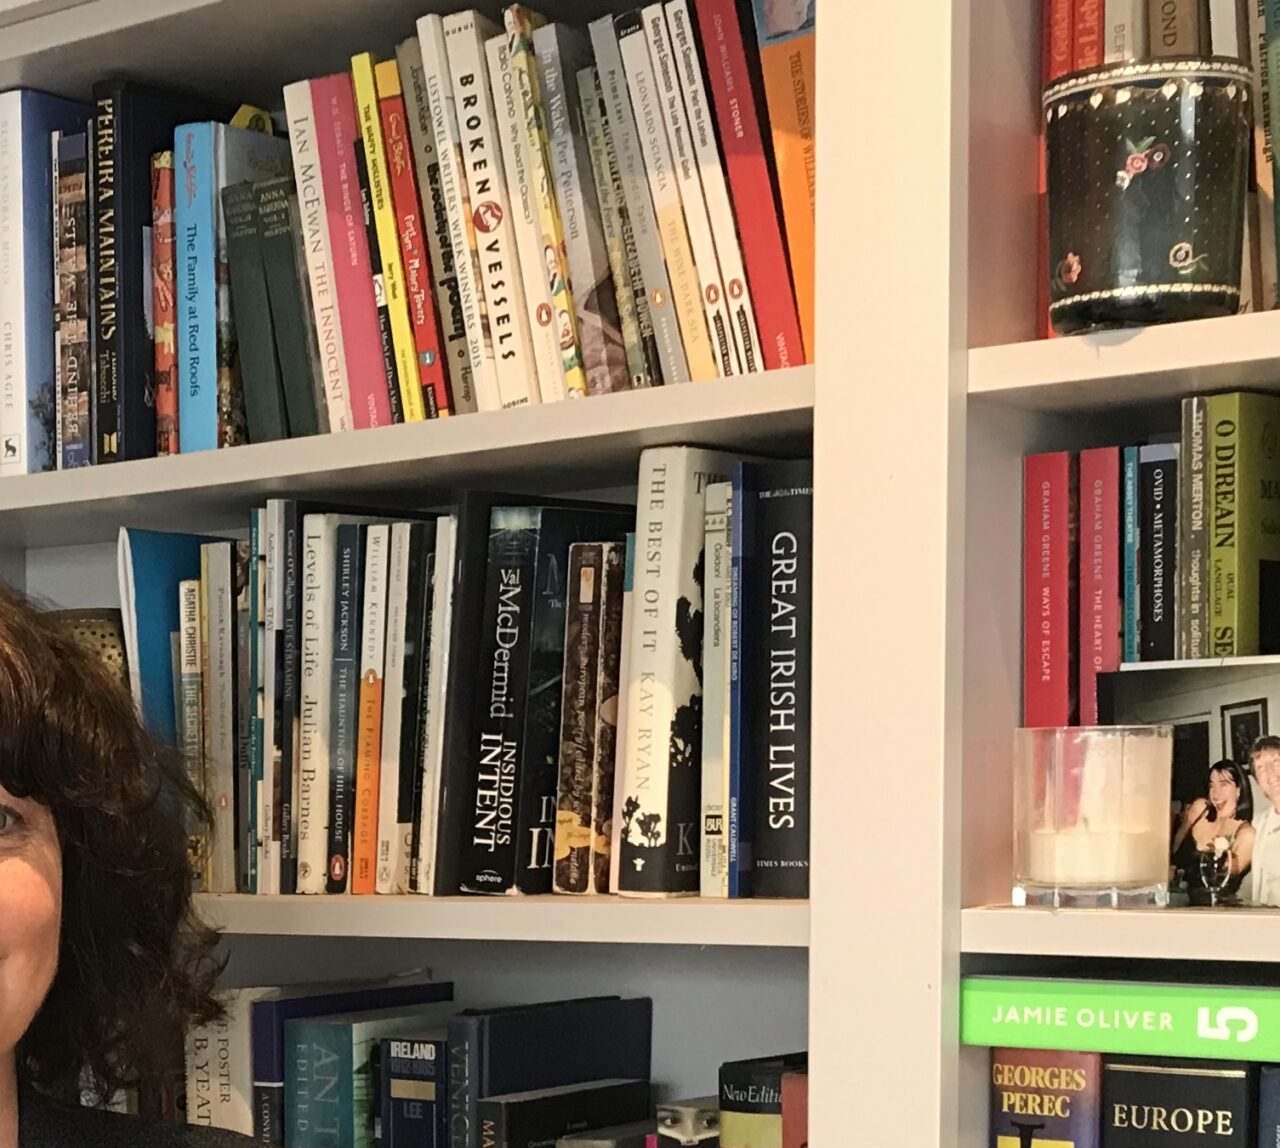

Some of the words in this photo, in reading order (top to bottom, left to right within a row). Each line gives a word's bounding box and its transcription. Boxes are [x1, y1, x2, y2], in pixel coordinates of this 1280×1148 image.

[540, 47, 552, 63] In
[544, 63, 558, 88] the
[364, 103, 372, 122] THE
[458, 72, 492, 196] BROKEN
[549, 90, 564, 135] Wake
[634, 70, 654, 138] LEONARDO
[649, 137, 668, 193] SCIASCIA
[97, 97, 115, 204] PEREIRA
[366, 122, 376, 153] HAPPY
[370, 155, 385, 211] HOLLISTERS
[428, 74, 447, 147] LISTOWEL
[452, 212, 464, 257] WEEK
[459, 258, 477, 331] WINNERS
[559, 168, 580, 241] Petterson
[186, 222, 197, 253] The
[97, 207, 116, 341] MAINTAINS
[186, 253, 198, 304] Family
[188, 303, 198, 320] at
[484, 239, 517, 362] VESSELS
[4, 322, 12, 365] CHRIS
[188, 322, 199, 351] Red
[5, 371, 13, 410] AGEE
[189, 353, 200, 398] Roofs
[1191, 410, 1203, 471] THOMAS
[650, 463, 667, 511] THE
[1041, 481, 1051, 530] GRAHAM
[1093, 479, 1103, 531] GRAHAM
[1153, 468, 1164, 502] OVID
[1191, 473, 1203, 531] MERTON
[305, 533, 323, 603] Levels
[370, 535, 382, 596] WILLIAM
[646, 516, 664, 579] BEST
[1041, 533, 1050, 580] GREENE
[1093, 534, 1102, 581] GREENE
[1152, 512, 1163, 624] METAMORPHOSES
[340, 547, 351, 599] SHIRLEY
[500, 567, 520, 586] Val
[770, 531, 798, 640] GREAT
[184, 586, 198, 619] AGATHA
[305, 607, 317, 625] of
[644, 588, 660, 620] OF
[1041, 586, 1051, 617] WAYS
[1094, 588, 1103, 612] THE
[185, 621, 198, 669] CHRISTIE
[339, 601, 350, 652] JACKSON
[366, 600, 379, 662] KENNEDY
[642, 627, 658, 653] IT
[1041, 619, 1050, 637] OF
[1093, 613, 1103, 655] HEART
[304, 632, 316, 681] Life
[490, 583, 521, 720] McDermid
[1041, 638, 1051, 683] ESCAPE
[338, 666, 349, 687] THE
[640, 671, 656, 720] KAY
[770, 645, 797, 733] IRISH
[303, 693, 317, 761] Julian
[336, 688, 348, 753] HAUNTING
[336, 754, 346, 771] OF
[635, 727, 653, 792] RYAN
[300, 765, 317, 843] Barnes
[335, 772, 345, 804] HILL
[472, 732, 503, 854] INTENT
[495, 740, 517, 846] INSIDIOUS
[768, 745, 796, 831] LIVES
[333, 803, 345, 843] HOUSE
[992, 1005, 1068, 1027] JAMIE
[1075, 1008, 1174, 1032] OLIVER
[218, 1033, 232, 1104] FOSTER
[389, 1041, 437, 1061] IRELAND
[296, 1043, 309, 1132] EDITED
[993, 1063, 1087, 1092] GEORGES
[402, 1101, 424, 1119] LEE
[1001, 1091, 1071, 1118] PEREC
[1112, 1103, 1235, 1136] EUROPE
